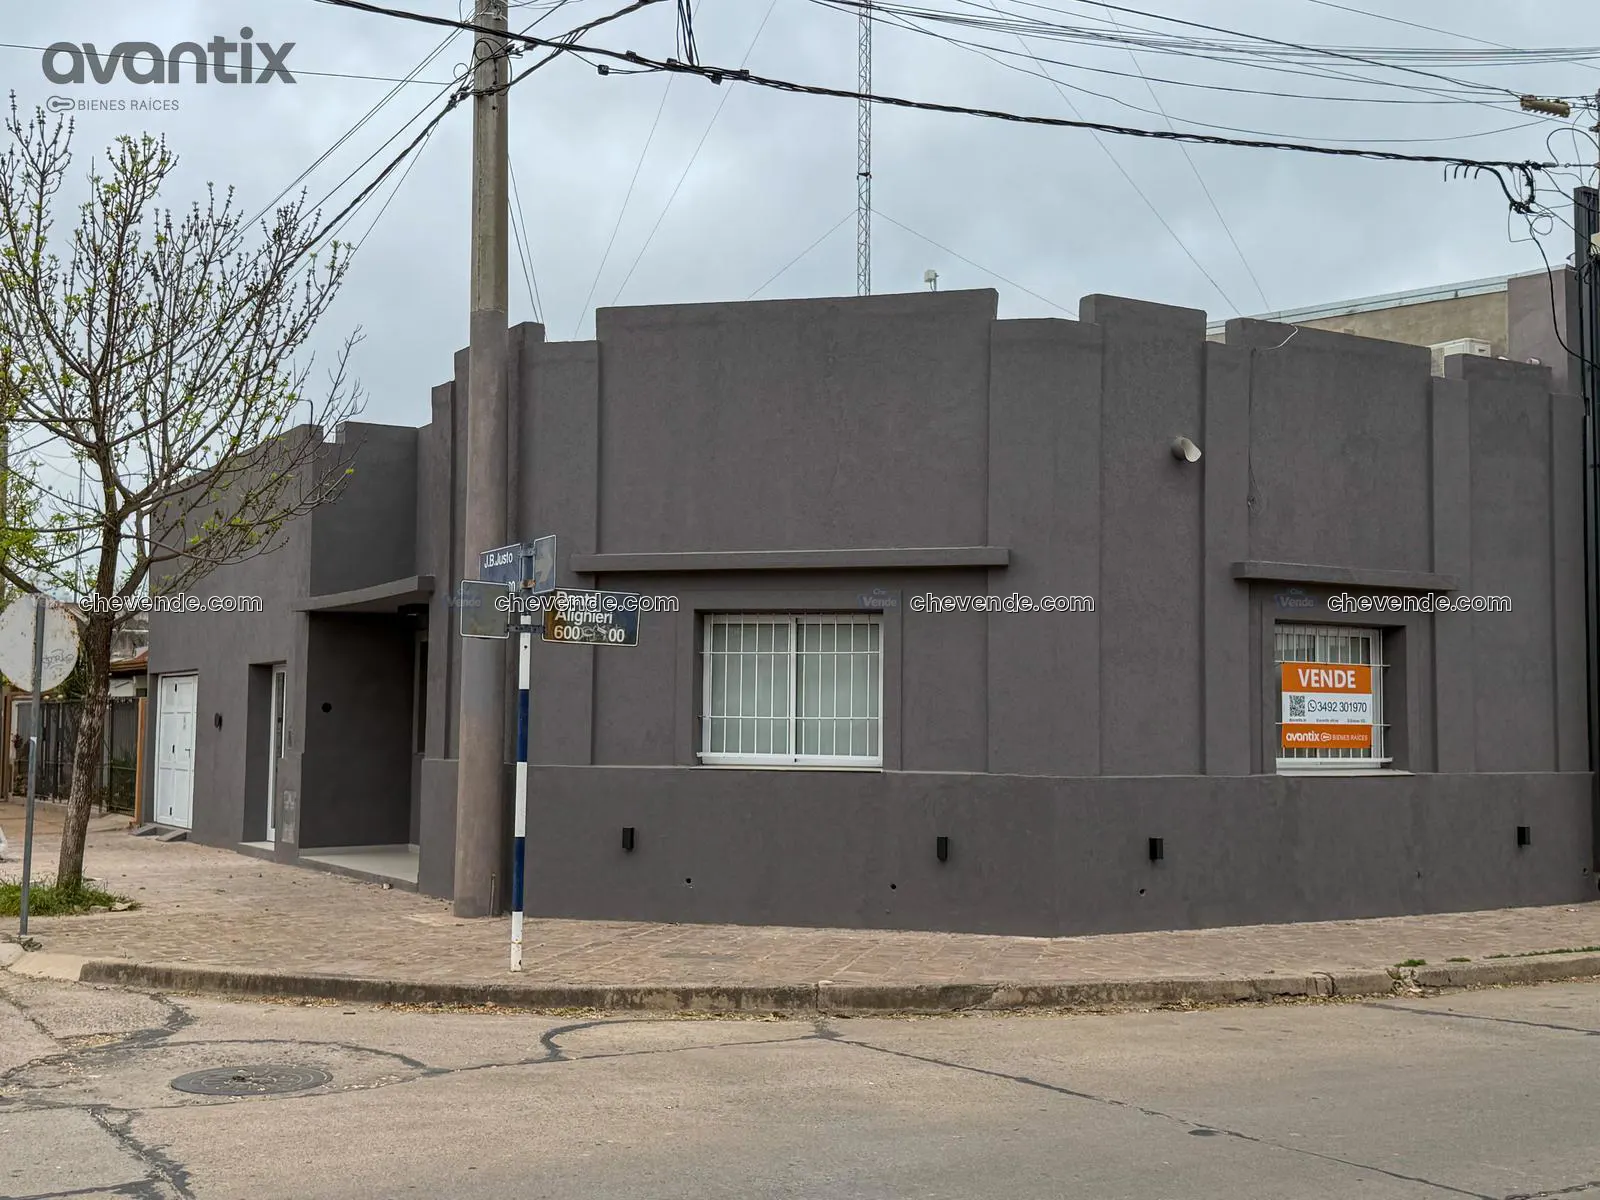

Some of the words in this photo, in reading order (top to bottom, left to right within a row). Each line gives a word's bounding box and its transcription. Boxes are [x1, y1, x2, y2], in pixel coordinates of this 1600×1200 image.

[554, 608, 613, 625] Alighieri
[1297, 668, 1357, 689] VENDE
[1317, 702, 1338, 713] 3492
[1339, 703, 1367, 713] 301970
[1286, 730, 1320, 742] avantix
